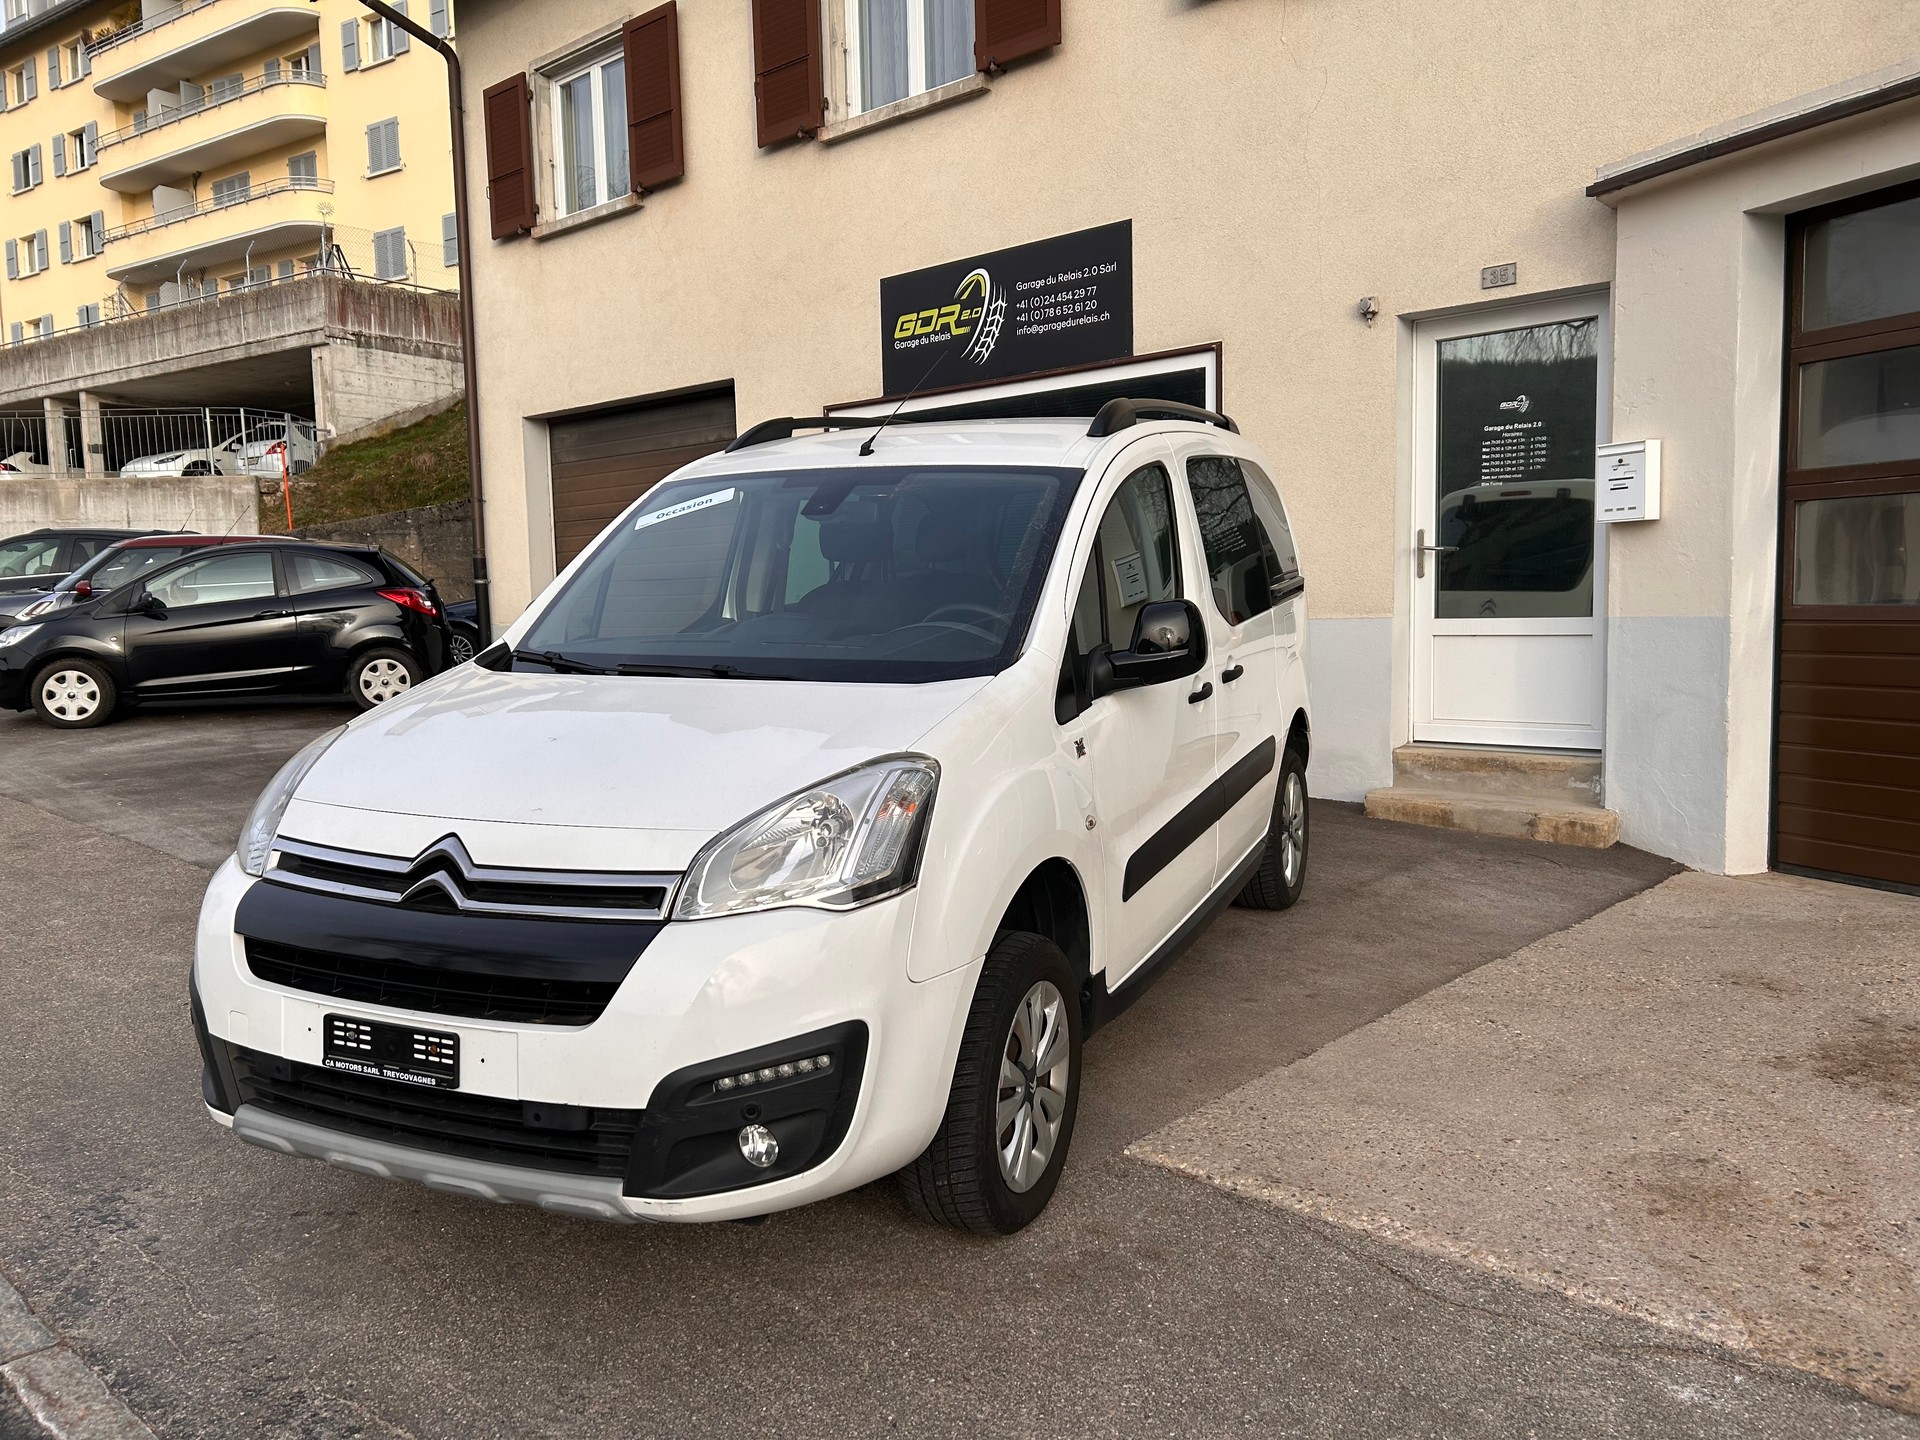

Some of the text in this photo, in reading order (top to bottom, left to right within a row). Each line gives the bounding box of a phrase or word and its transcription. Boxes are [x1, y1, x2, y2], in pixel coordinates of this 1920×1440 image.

[1016, 261, 1117, 291] Garage du Relais 2.0 Sàrl
[1490, 267, 1508, 284] 35
[1016, 286, 1097, 309] +41 (0)24 454 29 77
[894, 304, 982, 339] GDR 2.0
[1016, 300, 1097, 322] +41 (0)78 6 52 61 20
[1016, 310, 1110, 336] info@garagedurelais.ch
[894, 331, 951, 350] Garage du Relais
[656, 498, 713, 519] Occasion
[325, 1059, 436, 1086] CA MOTORS SARL TREYCOVAGNES
